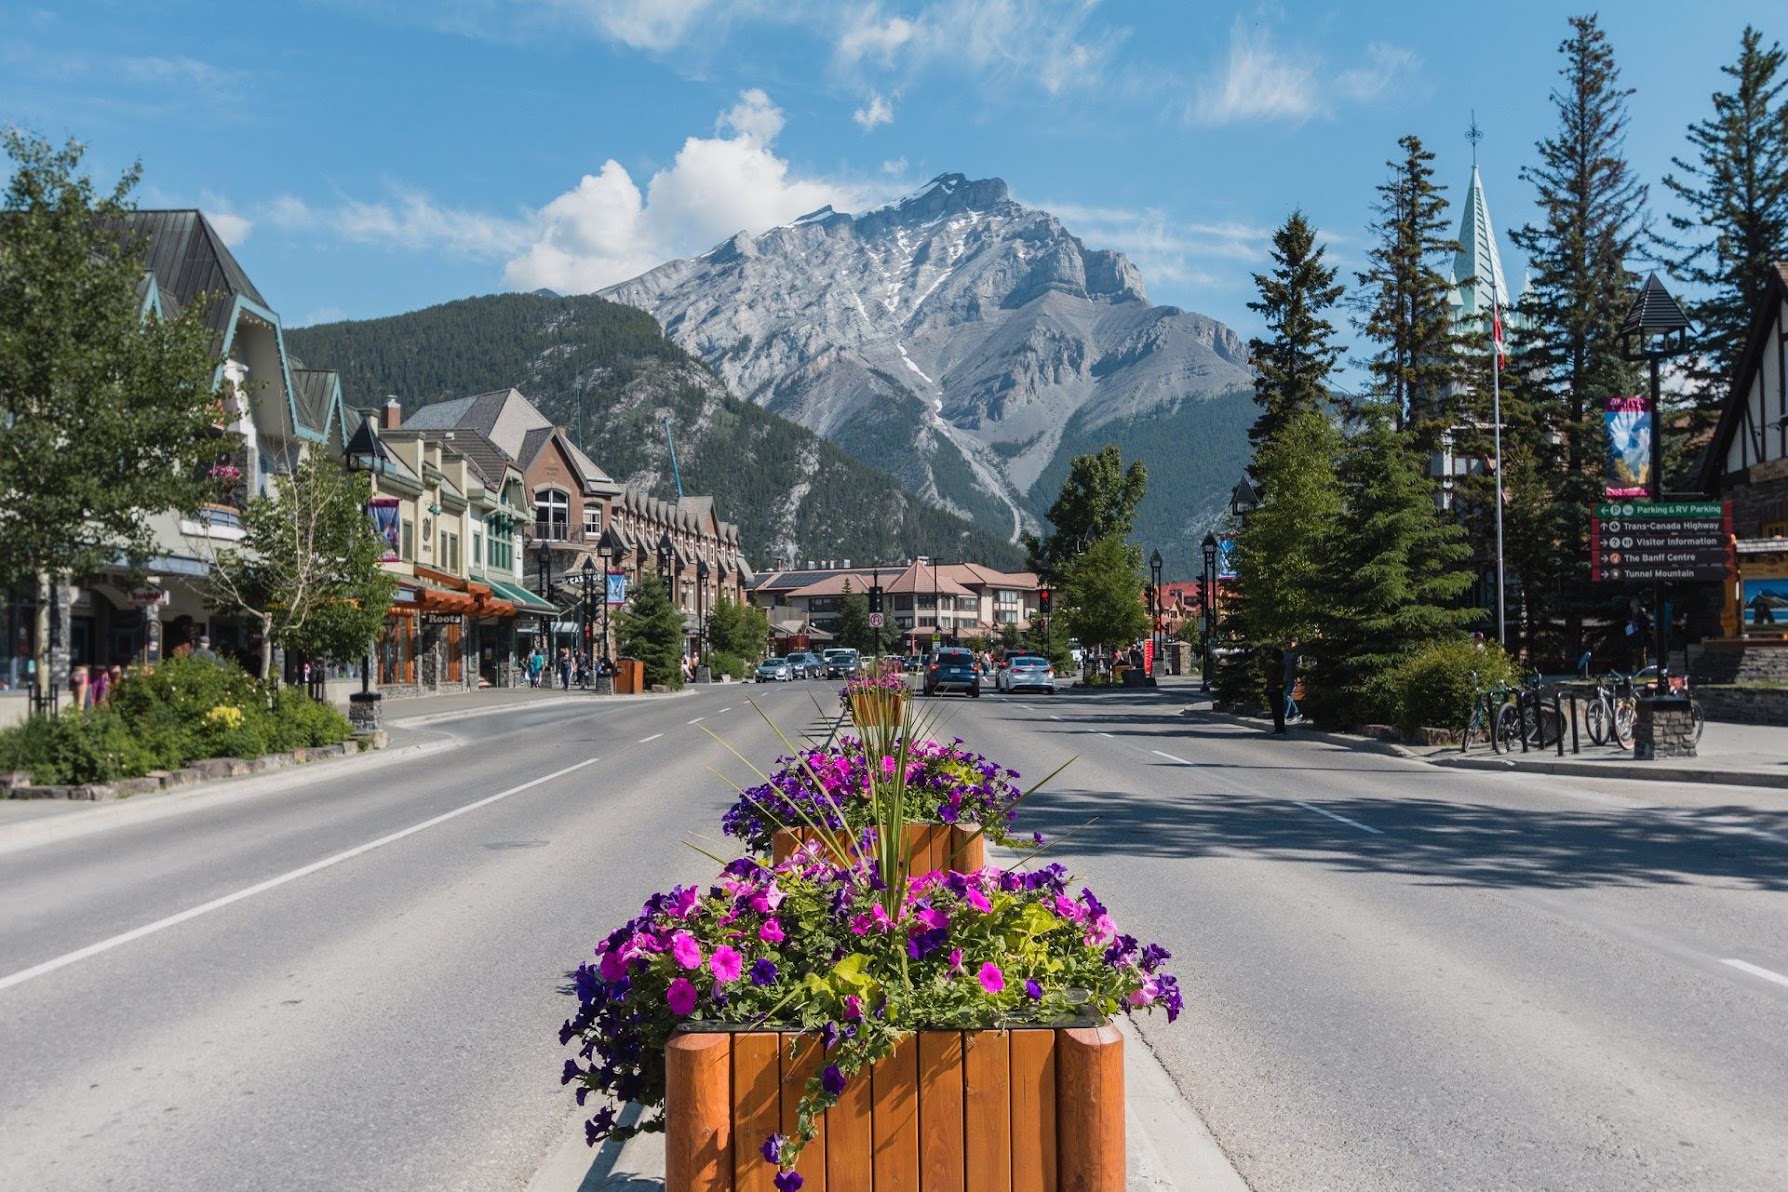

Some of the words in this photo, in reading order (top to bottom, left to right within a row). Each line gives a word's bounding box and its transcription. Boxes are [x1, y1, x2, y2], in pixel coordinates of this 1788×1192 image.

[1637, 506, 1667, 514] Parking
[1690, 505, 1721, 514] Parking
[1624, 522, 1681, 530] Trans-Canada
[1683, 522, 1719, 530] Highway
[1636, 538, 1665, 547] Visitor
[1667, 538, 1717, 546] Information
[1624, 554, 1639, 562] The
[1642, 554, 1664, 562] Banff
[1625, 570, 1652, 578] Tunnel
[1655, 570, 1694, 578] Mountain
[569, 575, 602, 585] CASDE
[428, 614, 461, 623] Roots
